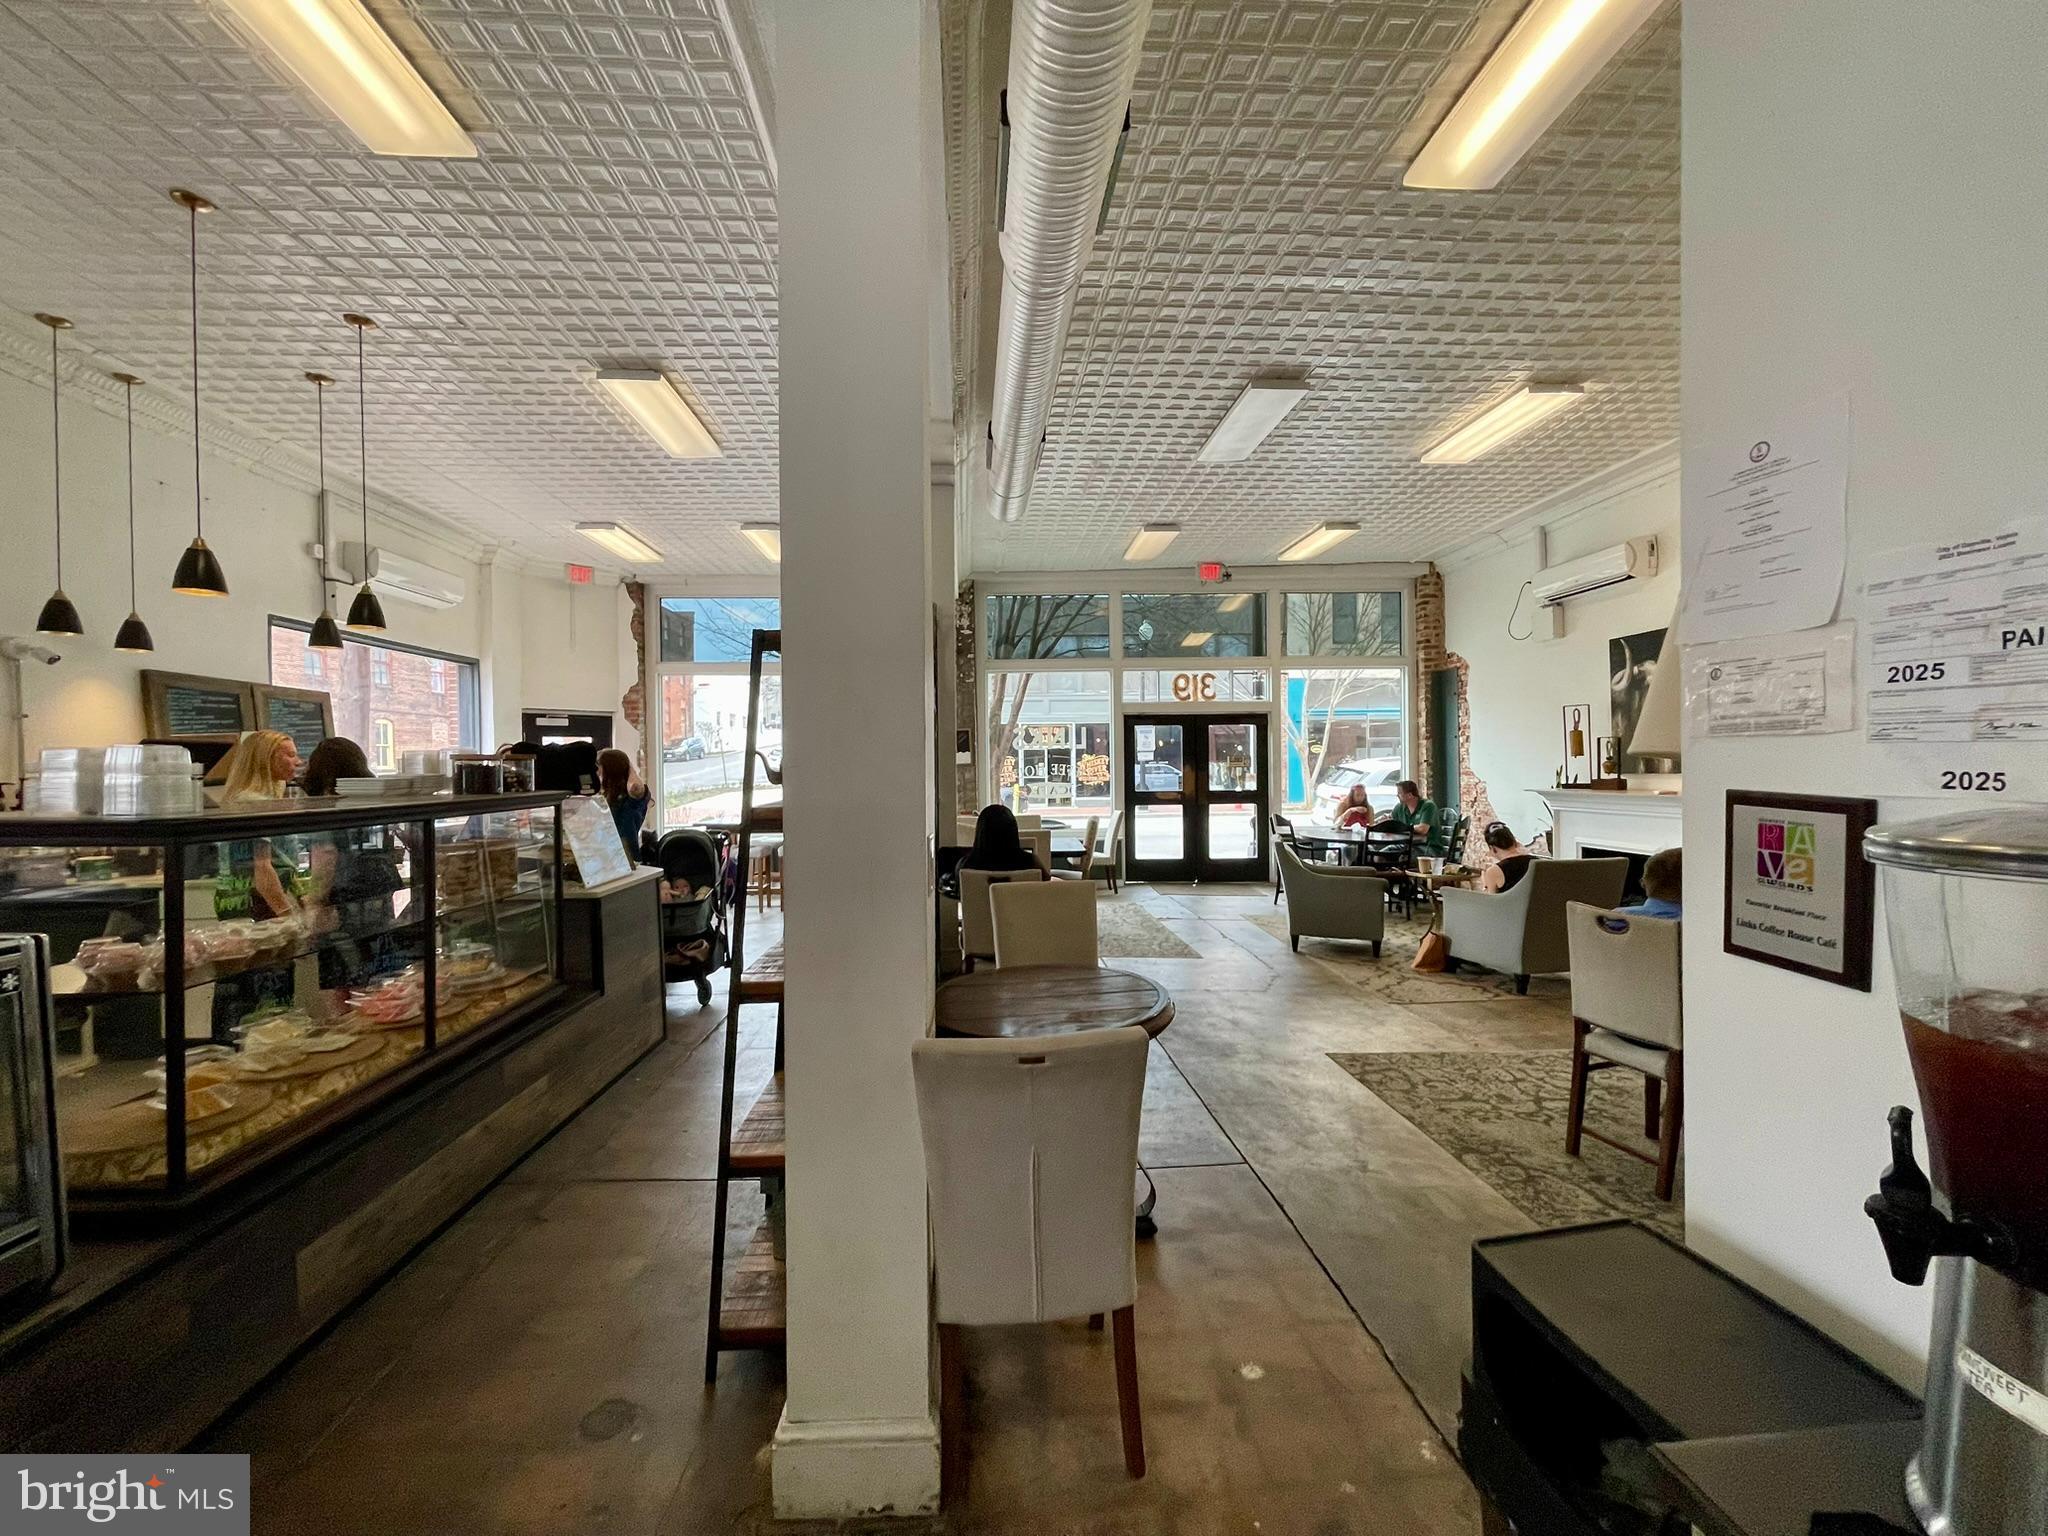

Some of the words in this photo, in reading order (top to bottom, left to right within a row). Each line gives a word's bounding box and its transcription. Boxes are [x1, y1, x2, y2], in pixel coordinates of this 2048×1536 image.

[1887, 662, 1946, 684] 2025
[1941, 771, 2007, 792] 2025
[1759, 922, 1785, 936] Coffee
[1787, 929, 1815, 944] House
